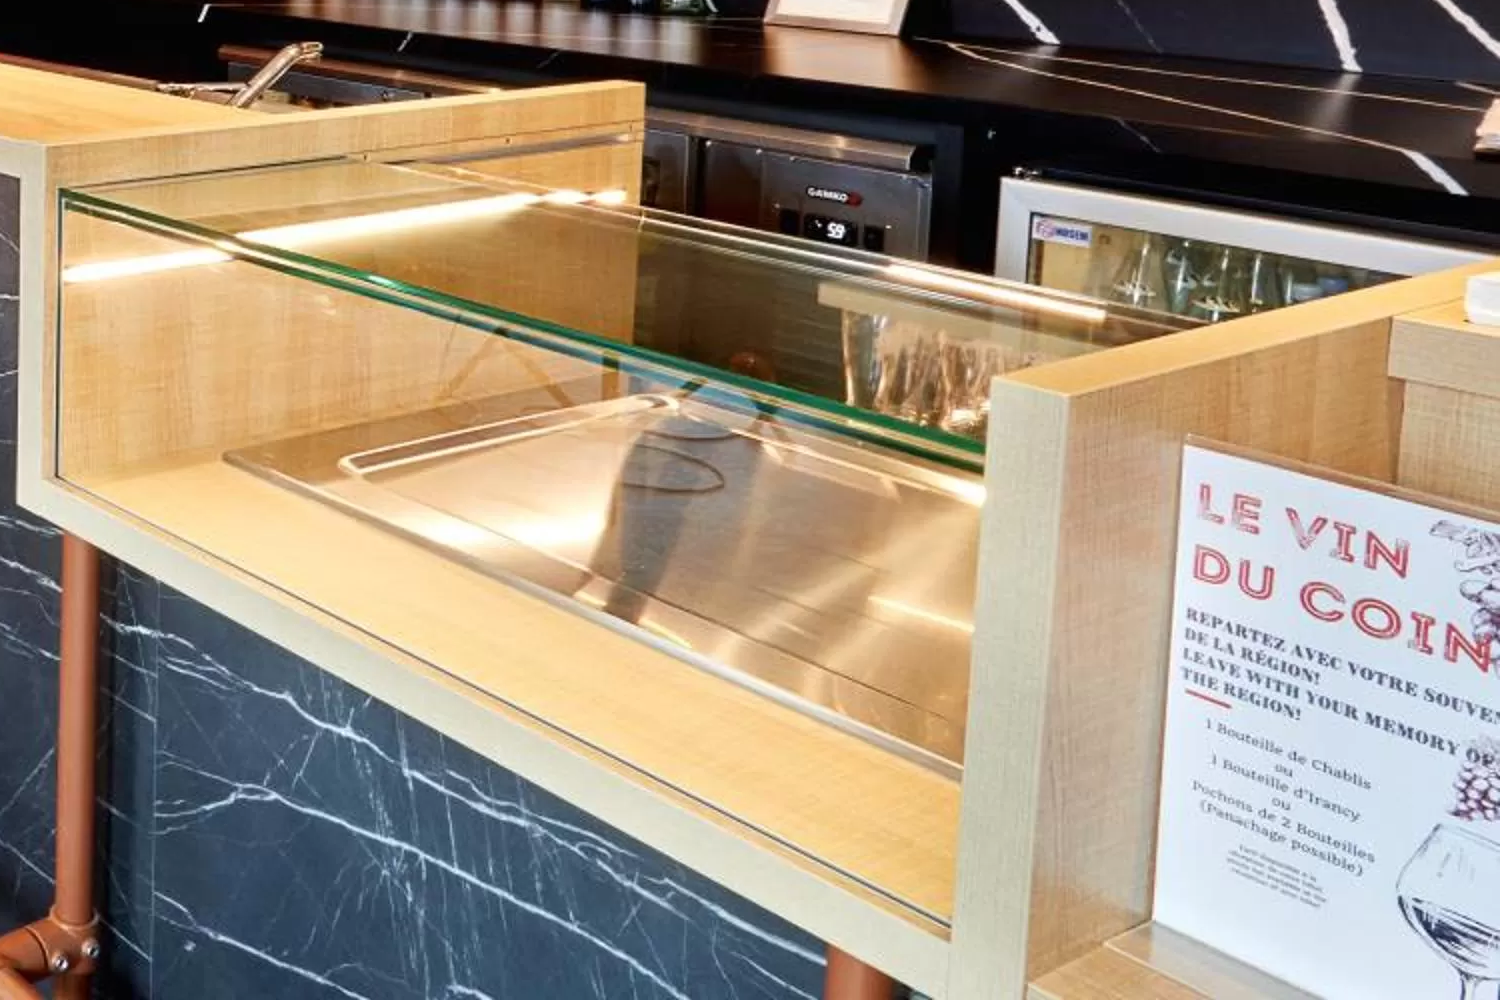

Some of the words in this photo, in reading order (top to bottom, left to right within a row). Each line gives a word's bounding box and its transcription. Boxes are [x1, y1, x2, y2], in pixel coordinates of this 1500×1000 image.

[1197, 483, 1263, 536] LE
[1285, 506, 1411, 580] VIN
[1193, 543, 1276, 601] DU
[1299, 580, 1494, 674] COIN
[1181, 667, 1218, 691] THE
[1185, 627, 1209, 646] DE
[1214, 637, 1235, 656] LA
[1241, 646, 1321, 686] RÉGION!
[1186, 607, 1285, 653] REPARTEZ
[1291, 644, 1342, 670] AVEC
[1348, 661, 1418, 697] VOTRE
[1423, 687, 1500, 725] SOUVE
[1183, 647, 1241, 679] LEAVE
[1247, 668, 1300, 699] WITH
[1307, 690, 1359, 721] YOUR
[1364, 711, 1460, 756] MEMORY
[1217, 722, 1284, 755] Bouteille
[1287, 751, 1308, 765] de
[1311, 759, 1372, 790] Chablis
[1223, 759, 1290, 793] Bouteille
[1274, 764, 1294, 778] ou
[1271, 797, 1292, 811] ou
[1258, 807, 1276, 821] de
[1281, 816, 1292, 829] 2
[1297, 821, 1376, 863] Bouteilles
[1291, 838, 1363, 877] possible)
